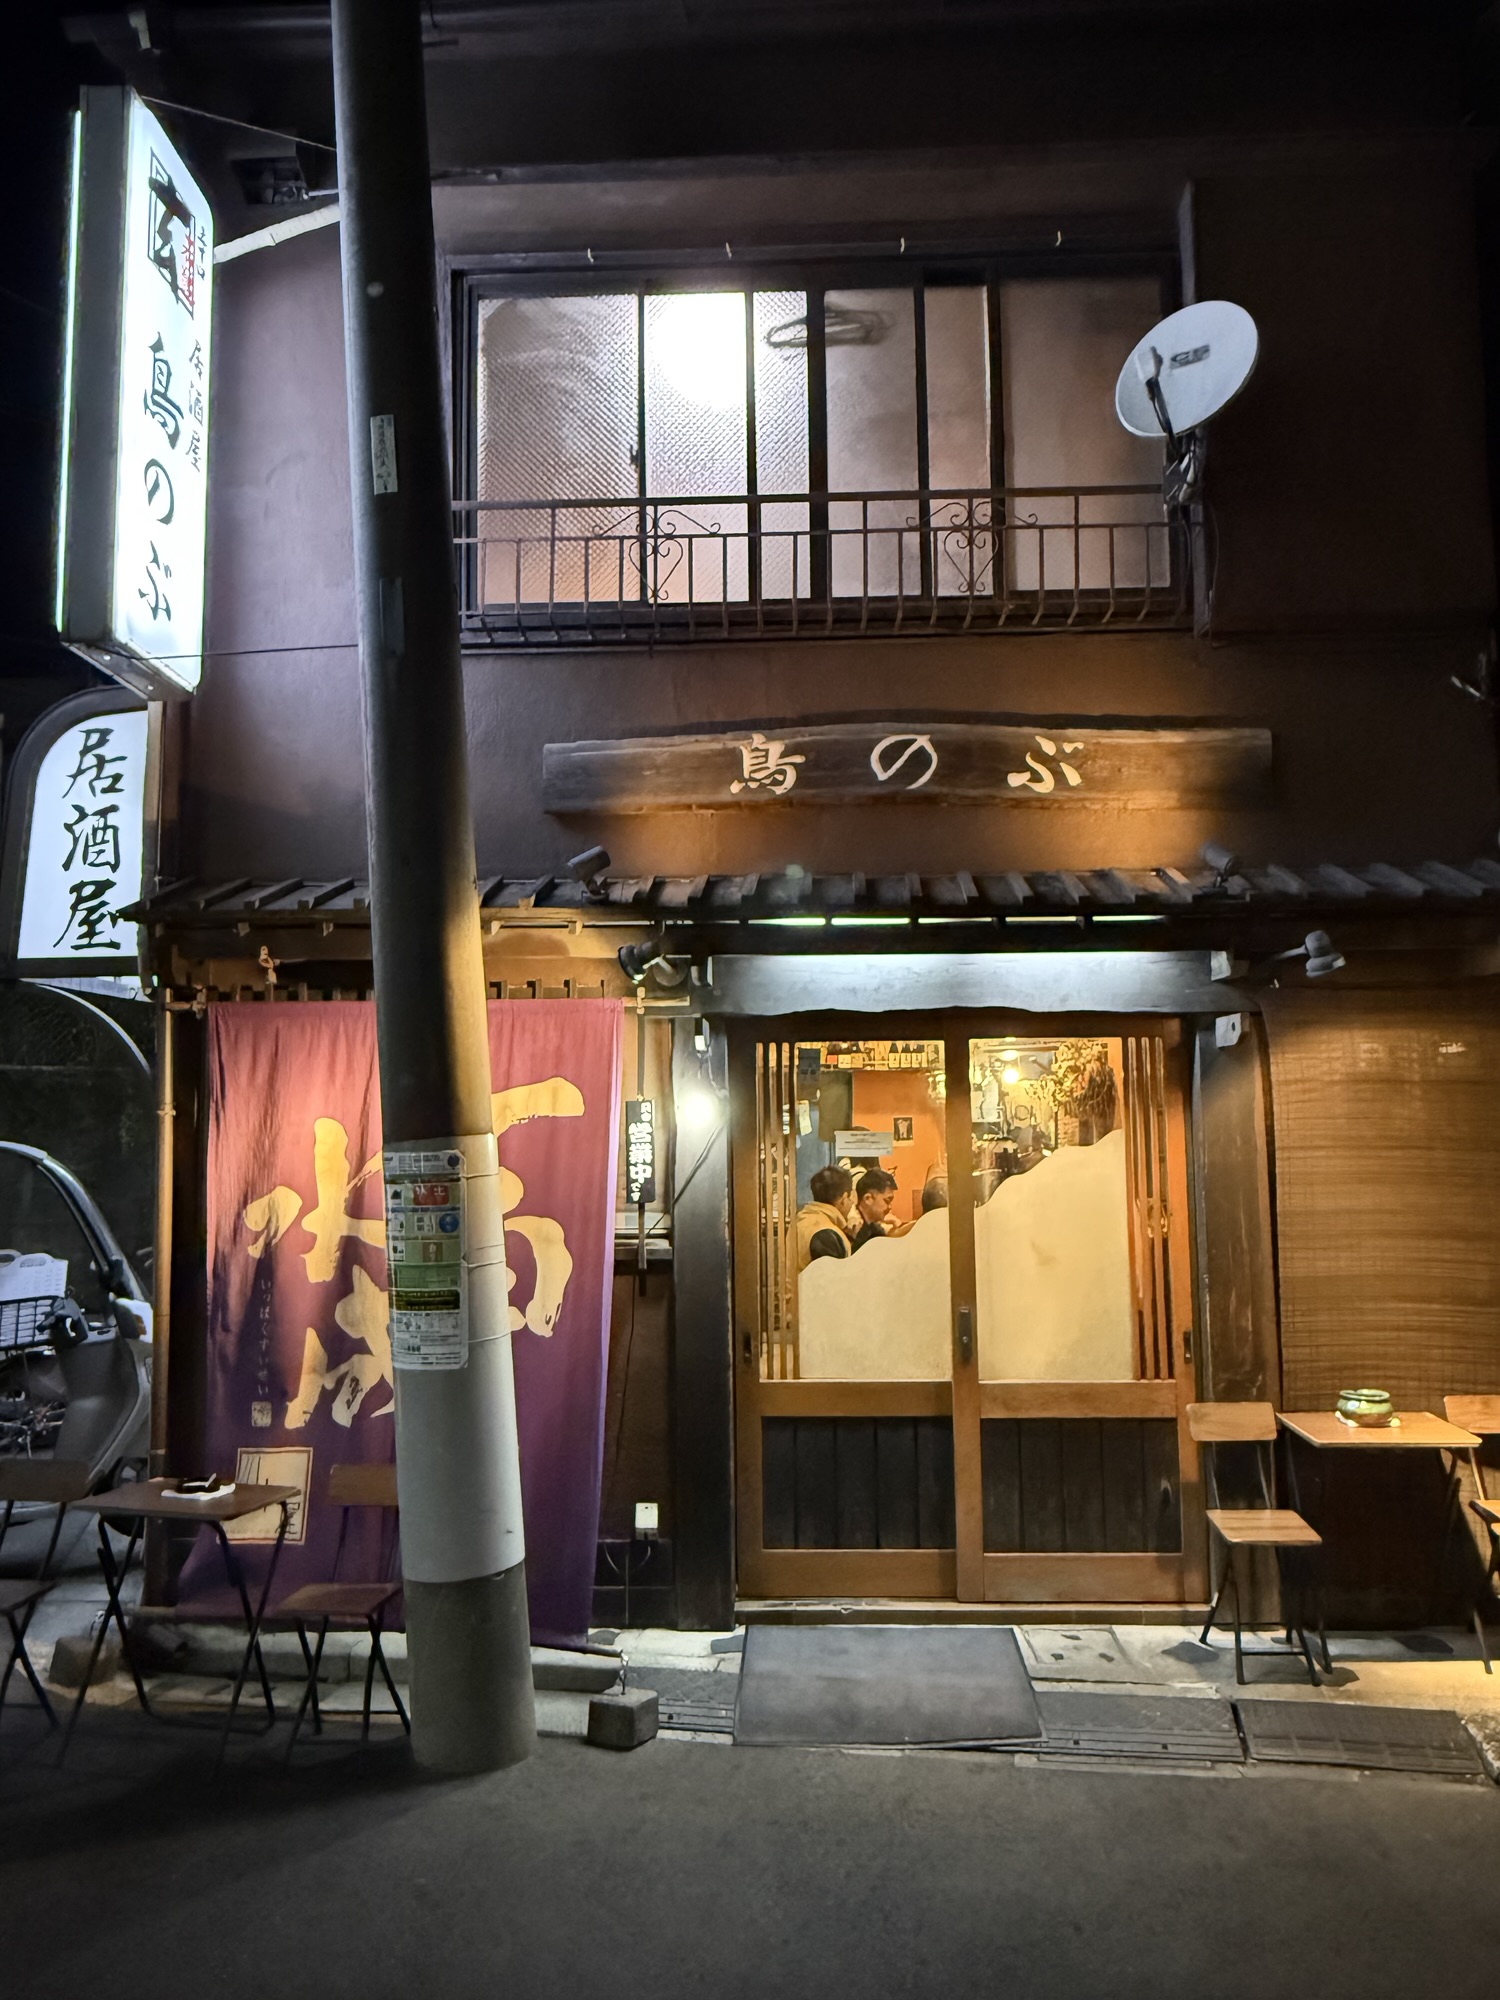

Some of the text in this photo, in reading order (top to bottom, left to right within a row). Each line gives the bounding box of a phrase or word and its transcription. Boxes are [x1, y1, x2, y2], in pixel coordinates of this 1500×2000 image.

[138, 331, 184, 623] 鳥のぶ
[185, 338, 204, 473] 居酒屋
[53, 728, 127, 951] 居酒屋
[730, 733, 1085, 795] 鳥のぶ
